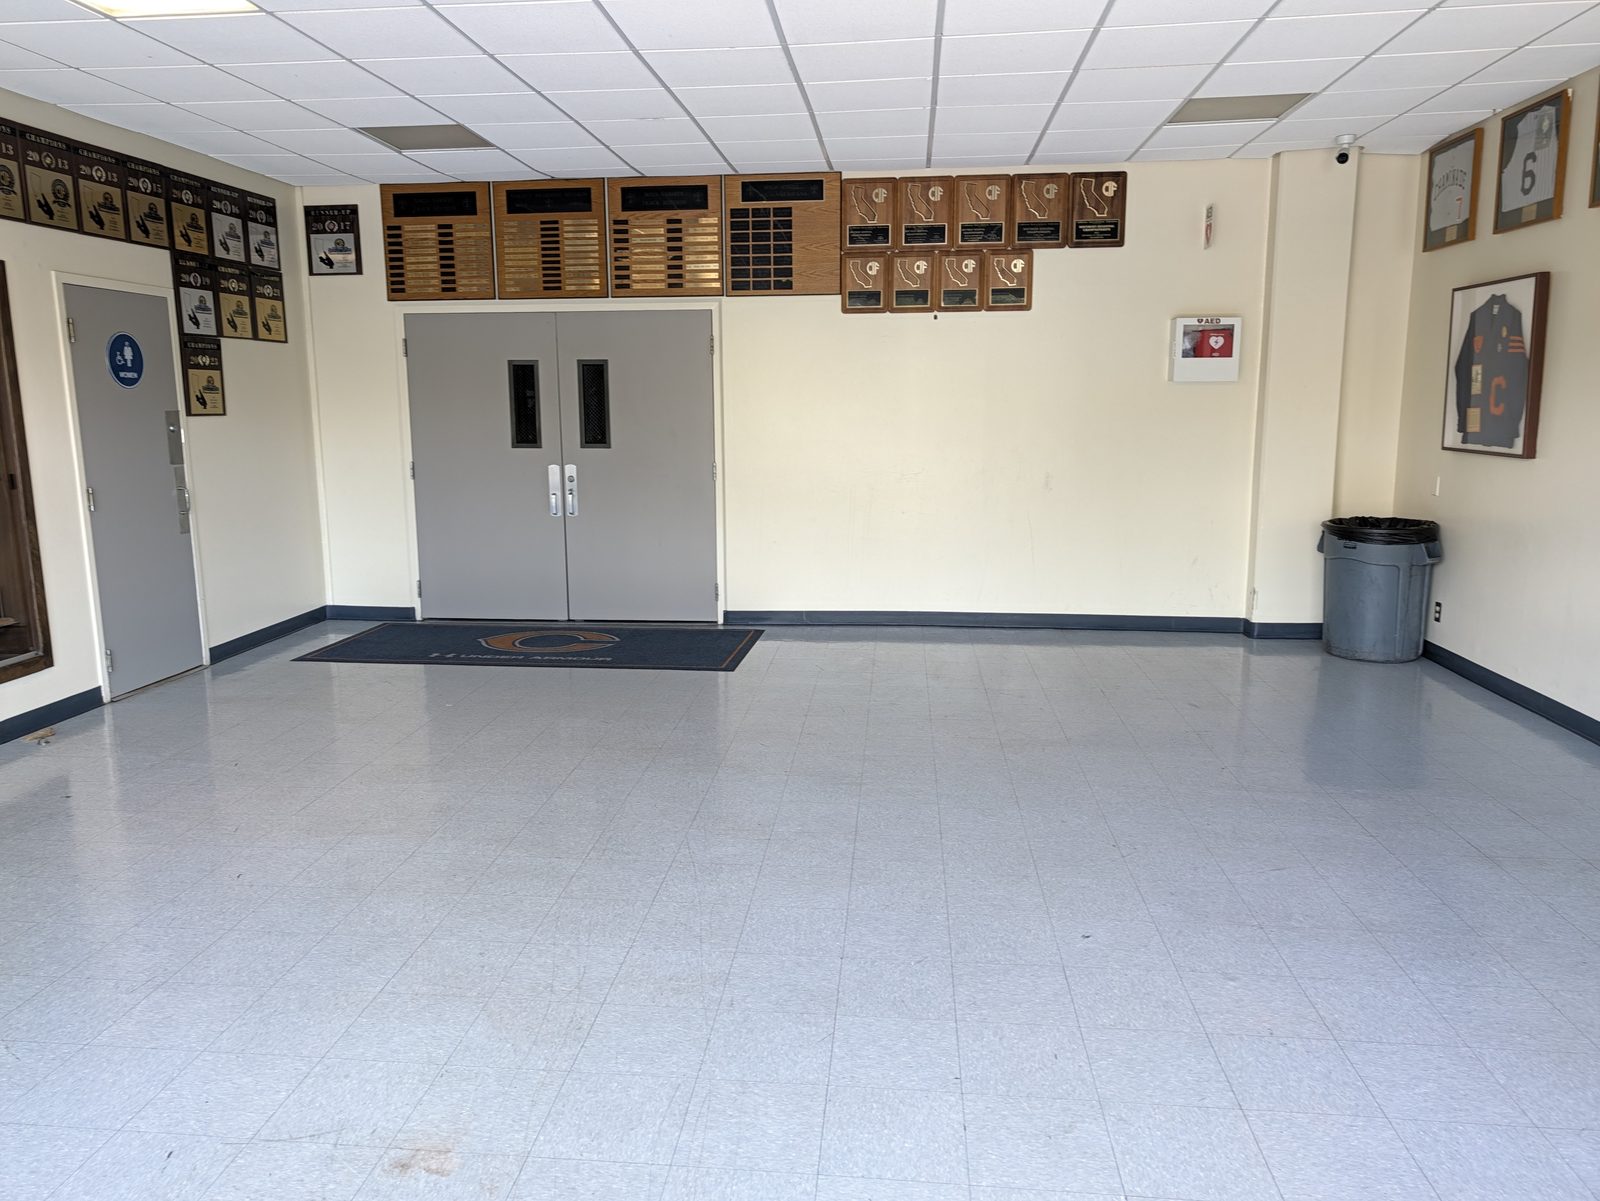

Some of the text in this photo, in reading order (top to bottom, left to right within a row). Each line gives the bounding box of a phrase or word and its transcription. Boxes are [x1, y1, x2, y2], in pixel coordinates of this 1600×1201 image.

[26, 133, 66, 150] CHAMPIONS
[26, 150, 69, 170] 20 13
[78, 148, 116, 164] CHAMPIONS
[79, 164, 118, 183] 20 13
[127, 162, 161, 176] CHAMPIONS
[1520, 151, 1537, 196] 6
[128, 177, 139, 188] 20
[312, 222, 324, 231] 20
[119, 371, 138, 379] WOMEN
[1489, 375, 1507, 416] C
